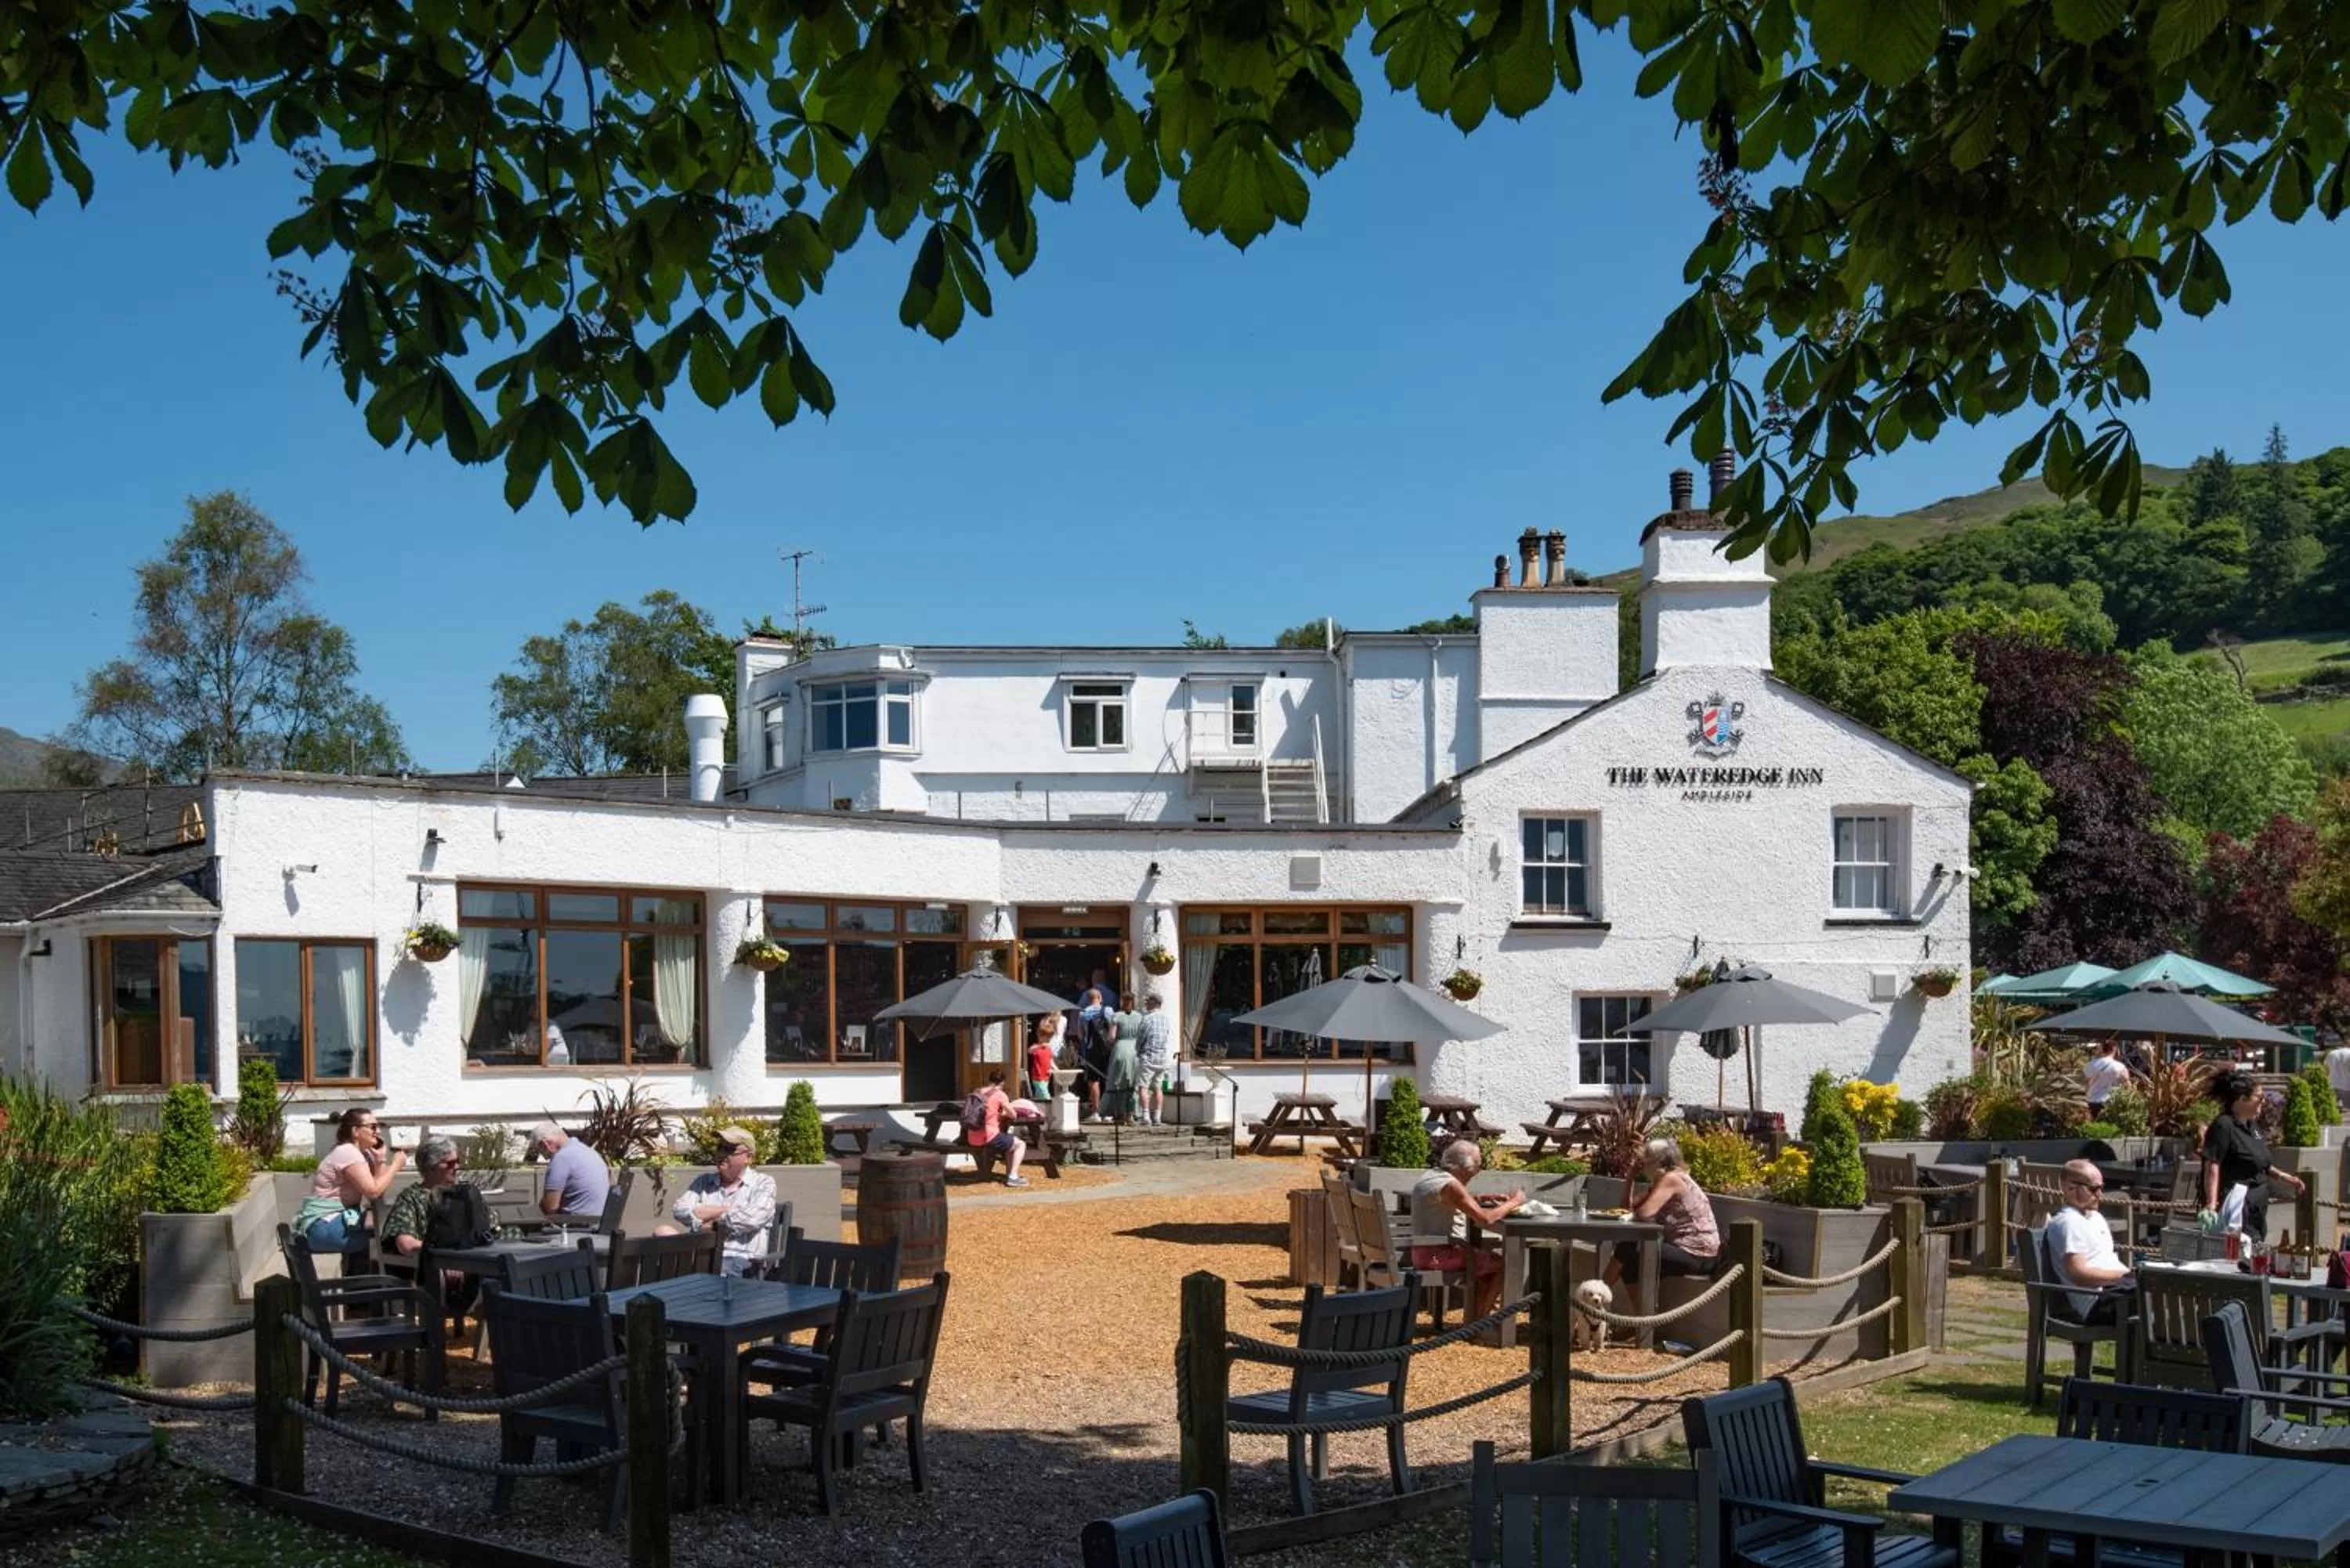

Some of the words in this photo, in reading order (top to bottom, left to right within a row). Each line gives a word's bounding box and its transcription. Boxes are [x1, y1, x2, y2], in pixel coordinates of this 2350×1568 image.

[1607, 767, 1648, 784] THE
[1654, 767, 1783, 784] WATEREDGE
[1789, 768, 1824, 784] INN
